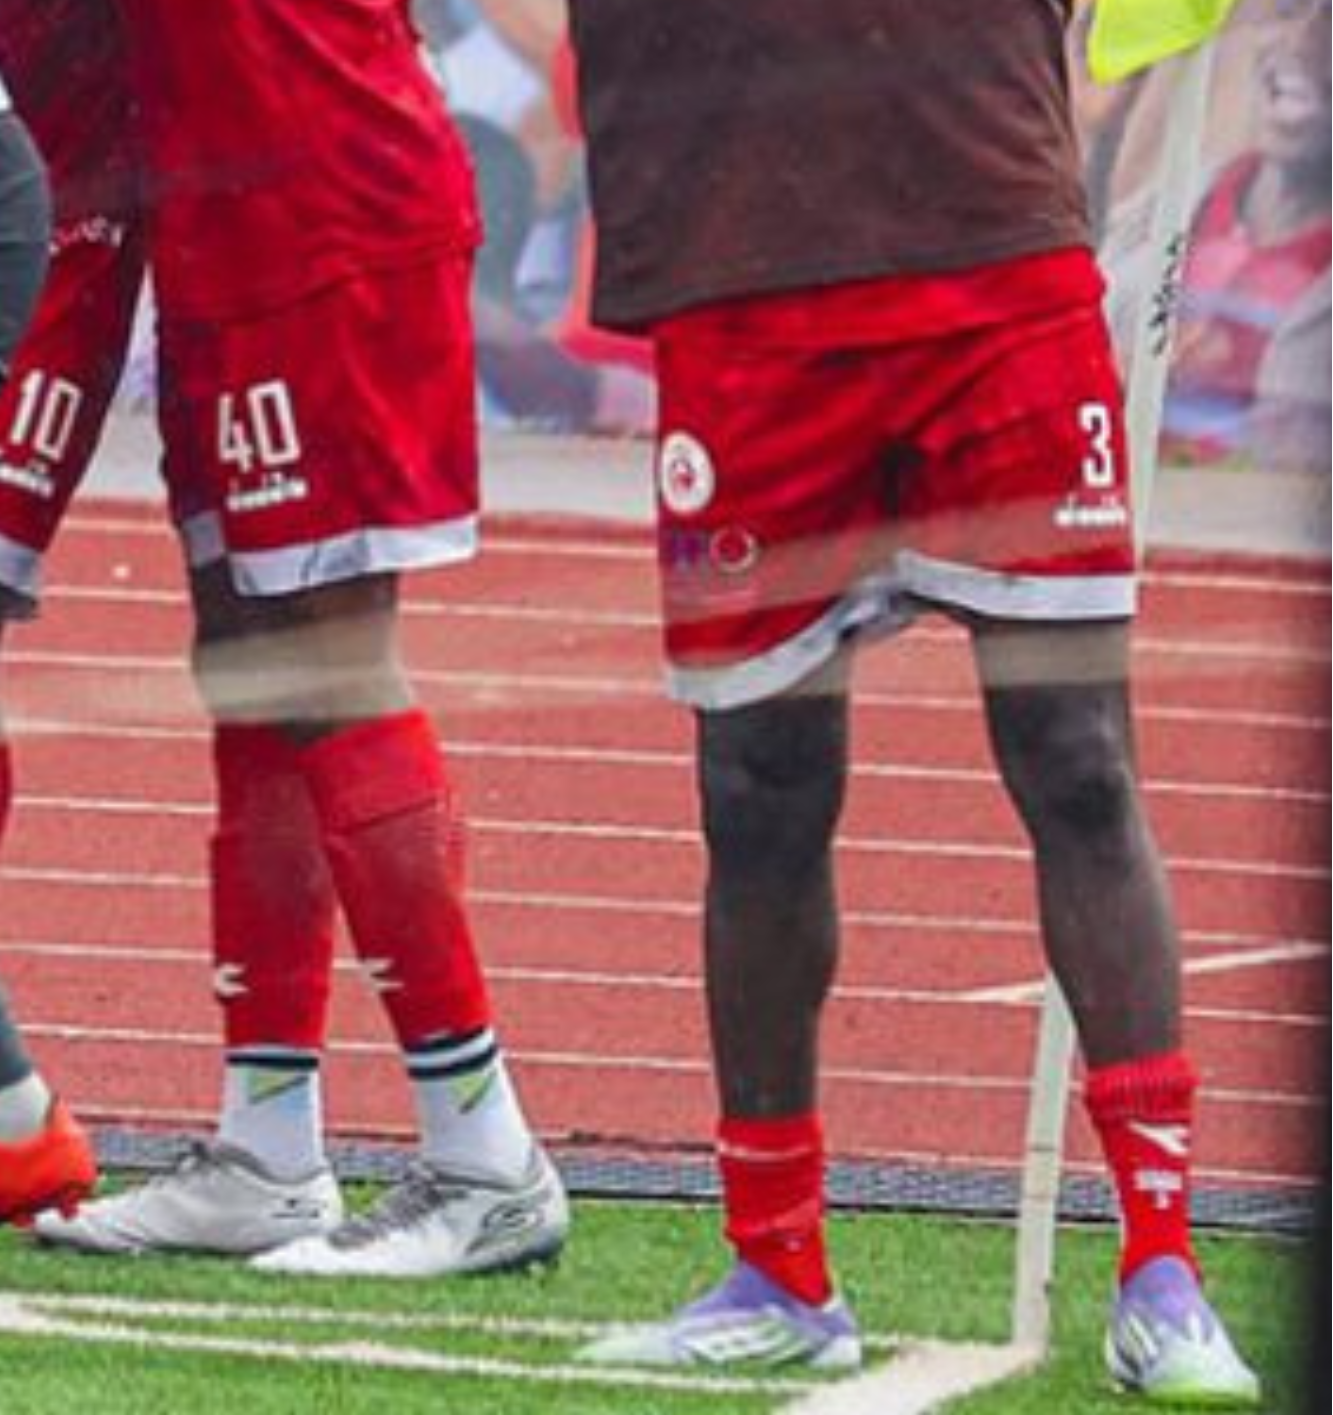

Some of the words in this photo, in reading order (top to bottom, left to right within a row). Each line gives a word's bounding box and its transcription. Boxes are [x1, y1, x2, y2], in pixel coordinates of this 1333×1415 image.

[8, 369, 82, 462] 10
[217, 379, 301, 472] 40
[1079, 403, 1113, 486] 3
